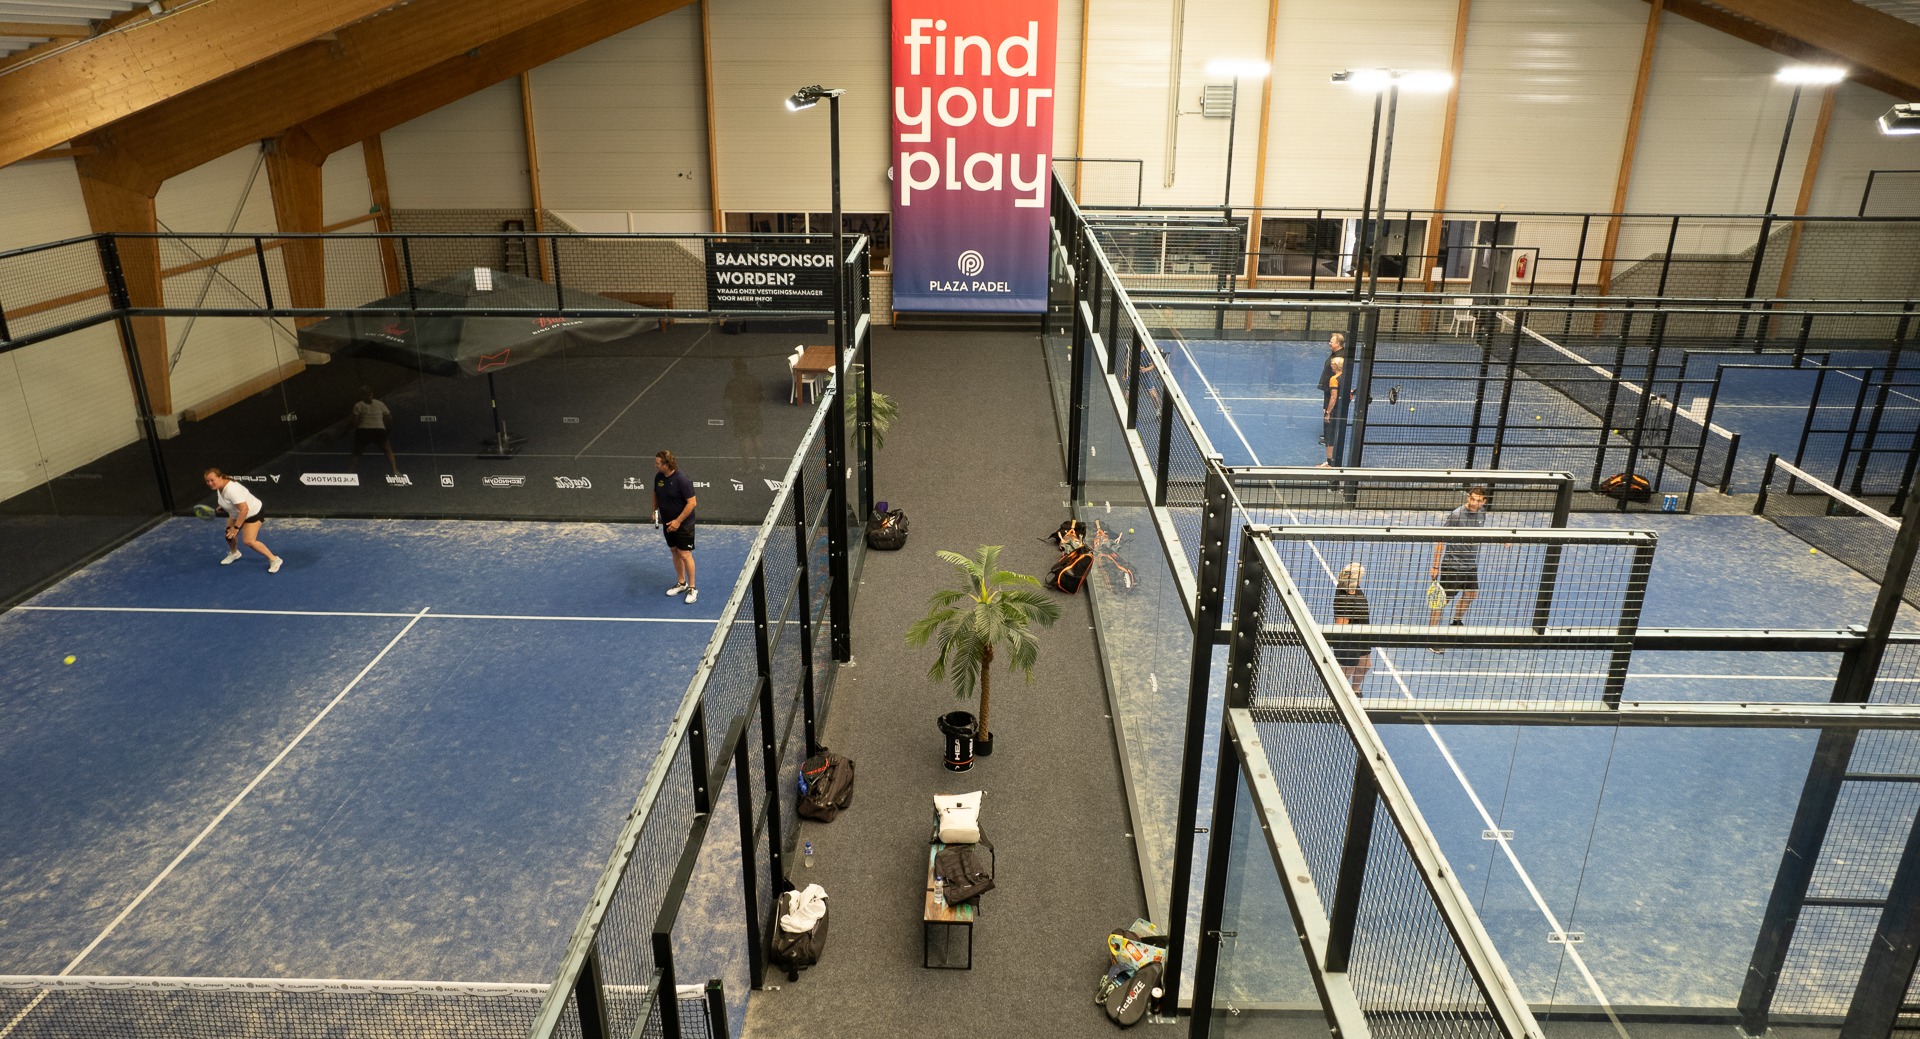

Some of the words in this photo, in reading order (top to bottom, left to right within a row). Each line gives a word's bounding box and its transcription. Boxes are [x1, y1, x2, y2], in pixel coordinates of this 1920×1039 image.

[904, 18, 1038, 77] find
[895, 86, 1052, 143] your
[901, 137, 1047, 208] play
[715, 252, 834, 268] BAANSPONSOR
[716, 271, 796, 286] WORDEN?
[929, 280, 969, 292] PLAZA
[972, 281, 1011, 293] PADEL
[757, 288, 823, 296] VESTIGINGSMANAGER
